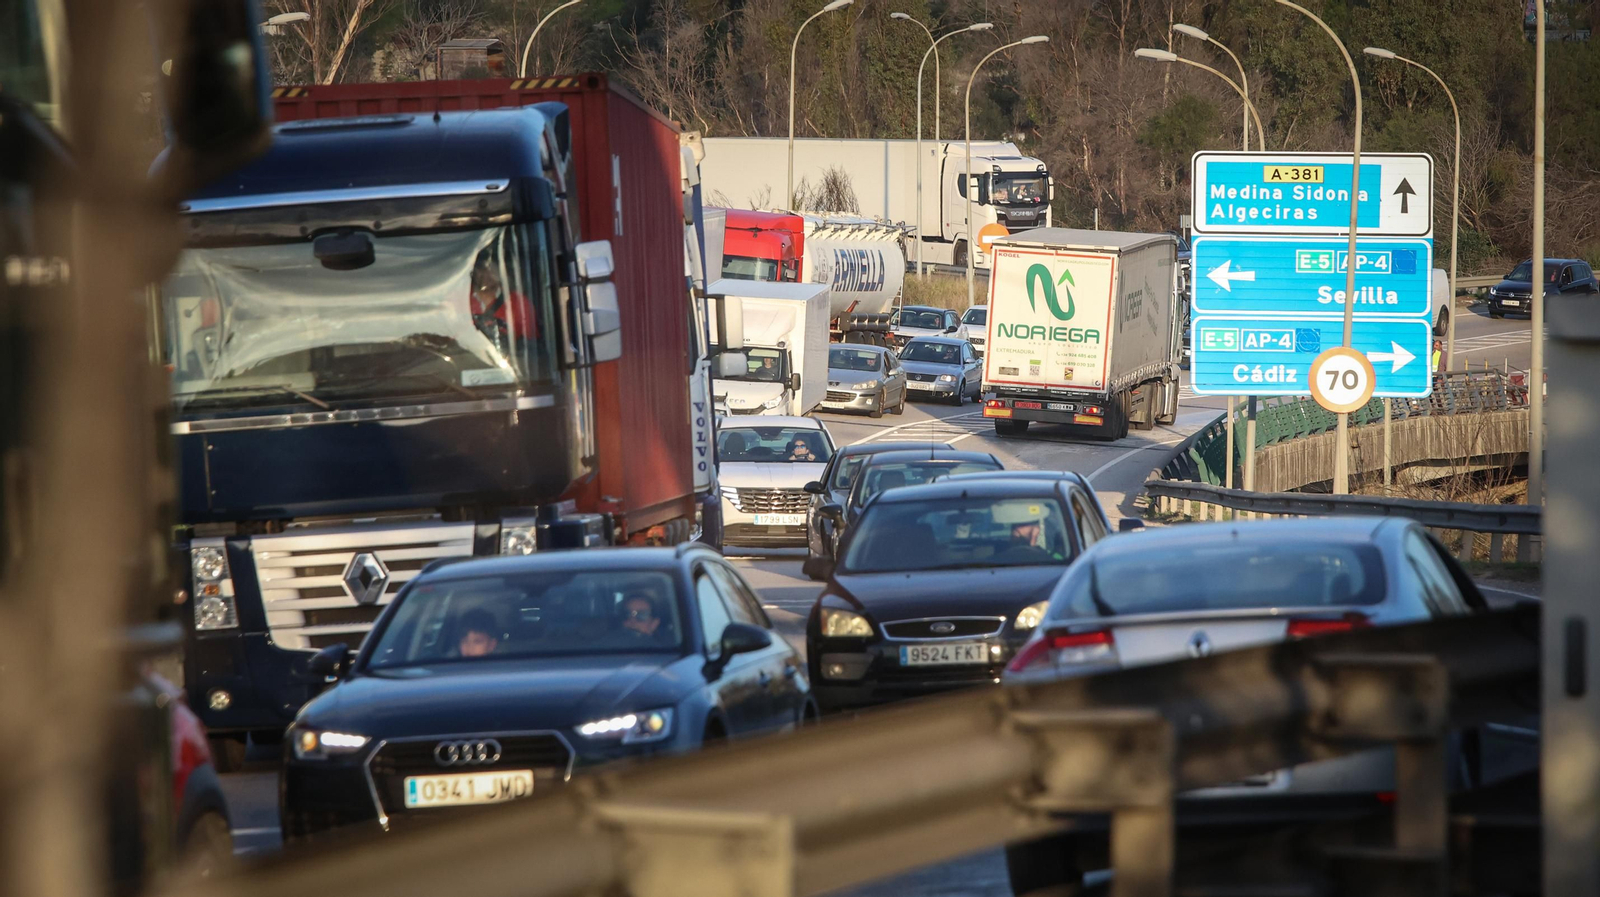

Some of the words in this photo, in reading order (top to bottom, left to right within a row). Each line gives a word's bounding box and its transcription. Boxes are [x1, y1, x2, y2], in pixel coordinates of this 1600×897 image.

[1271, 168, 1319, 181] A-381
[1210, 184, 1283, 200] Medina
[1292, 185, 1369, 202] Sidona
[1211, 203, 1318, 223] Algeciras
[831, 248, 885, 292] ARNIELLA
[1299, 254, 1331, 269] E-5
[997, 322, 1100, 344] NORIEGA
[1204, 332, 1236, 348] E-5
[1245, 333, 1292, 349] AP-4
[995, 347, 1035, 355] EXTREMADURA
[1232, 364, 1297, 383] Cádiz
[1325, 370, 1359, 390] 70
[693, 401, 708, 472] VOLVO
[760, 515, 780, 524] 1799
[782, 515, 799, 524] LSN
[911, 645, 949, 662] 9524
[955, 645, 983, 660] FKT
[422, 779, 475, 801] 0341
[487, 775, 527, 799] JMD
